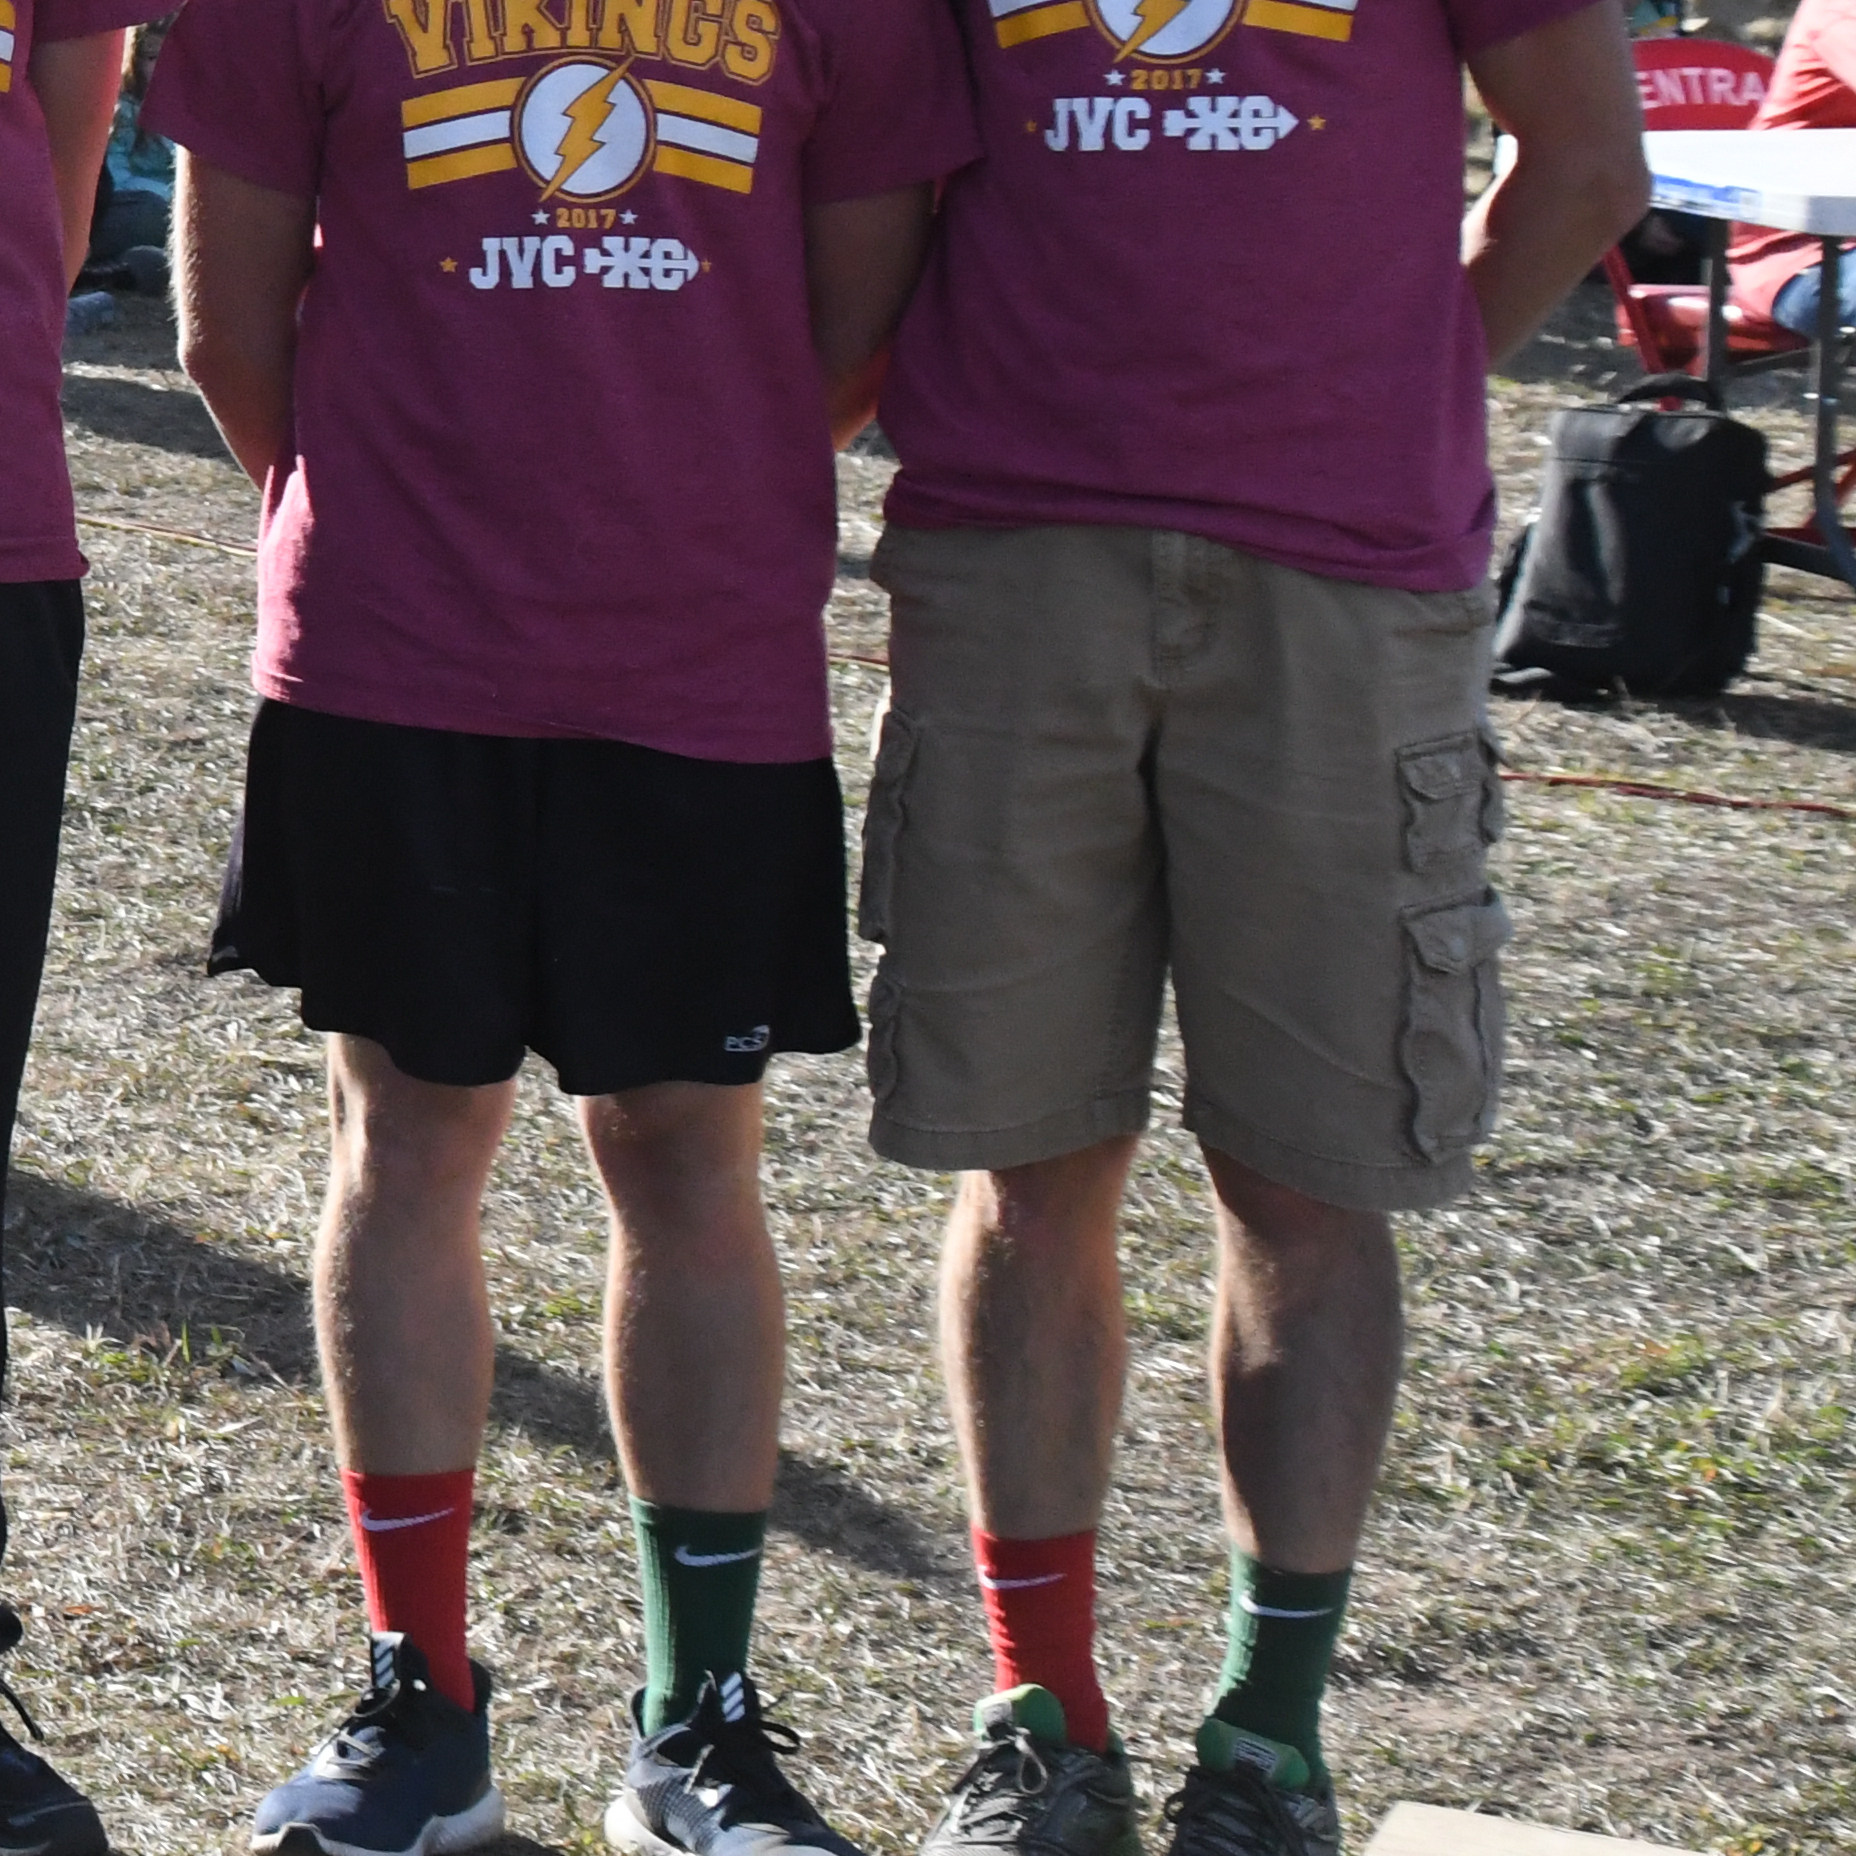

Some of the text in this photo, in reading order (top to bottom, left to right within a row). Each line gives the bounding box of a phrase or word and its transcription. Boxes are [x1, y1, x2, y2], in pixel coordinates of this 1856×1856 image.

[1130, 68, 1203, 90] 2017
[1044, 95, 1276, 151] JVC XC
[555, 207, 617, 228] 2017
[468, 235, 685, 291] JVC XC
